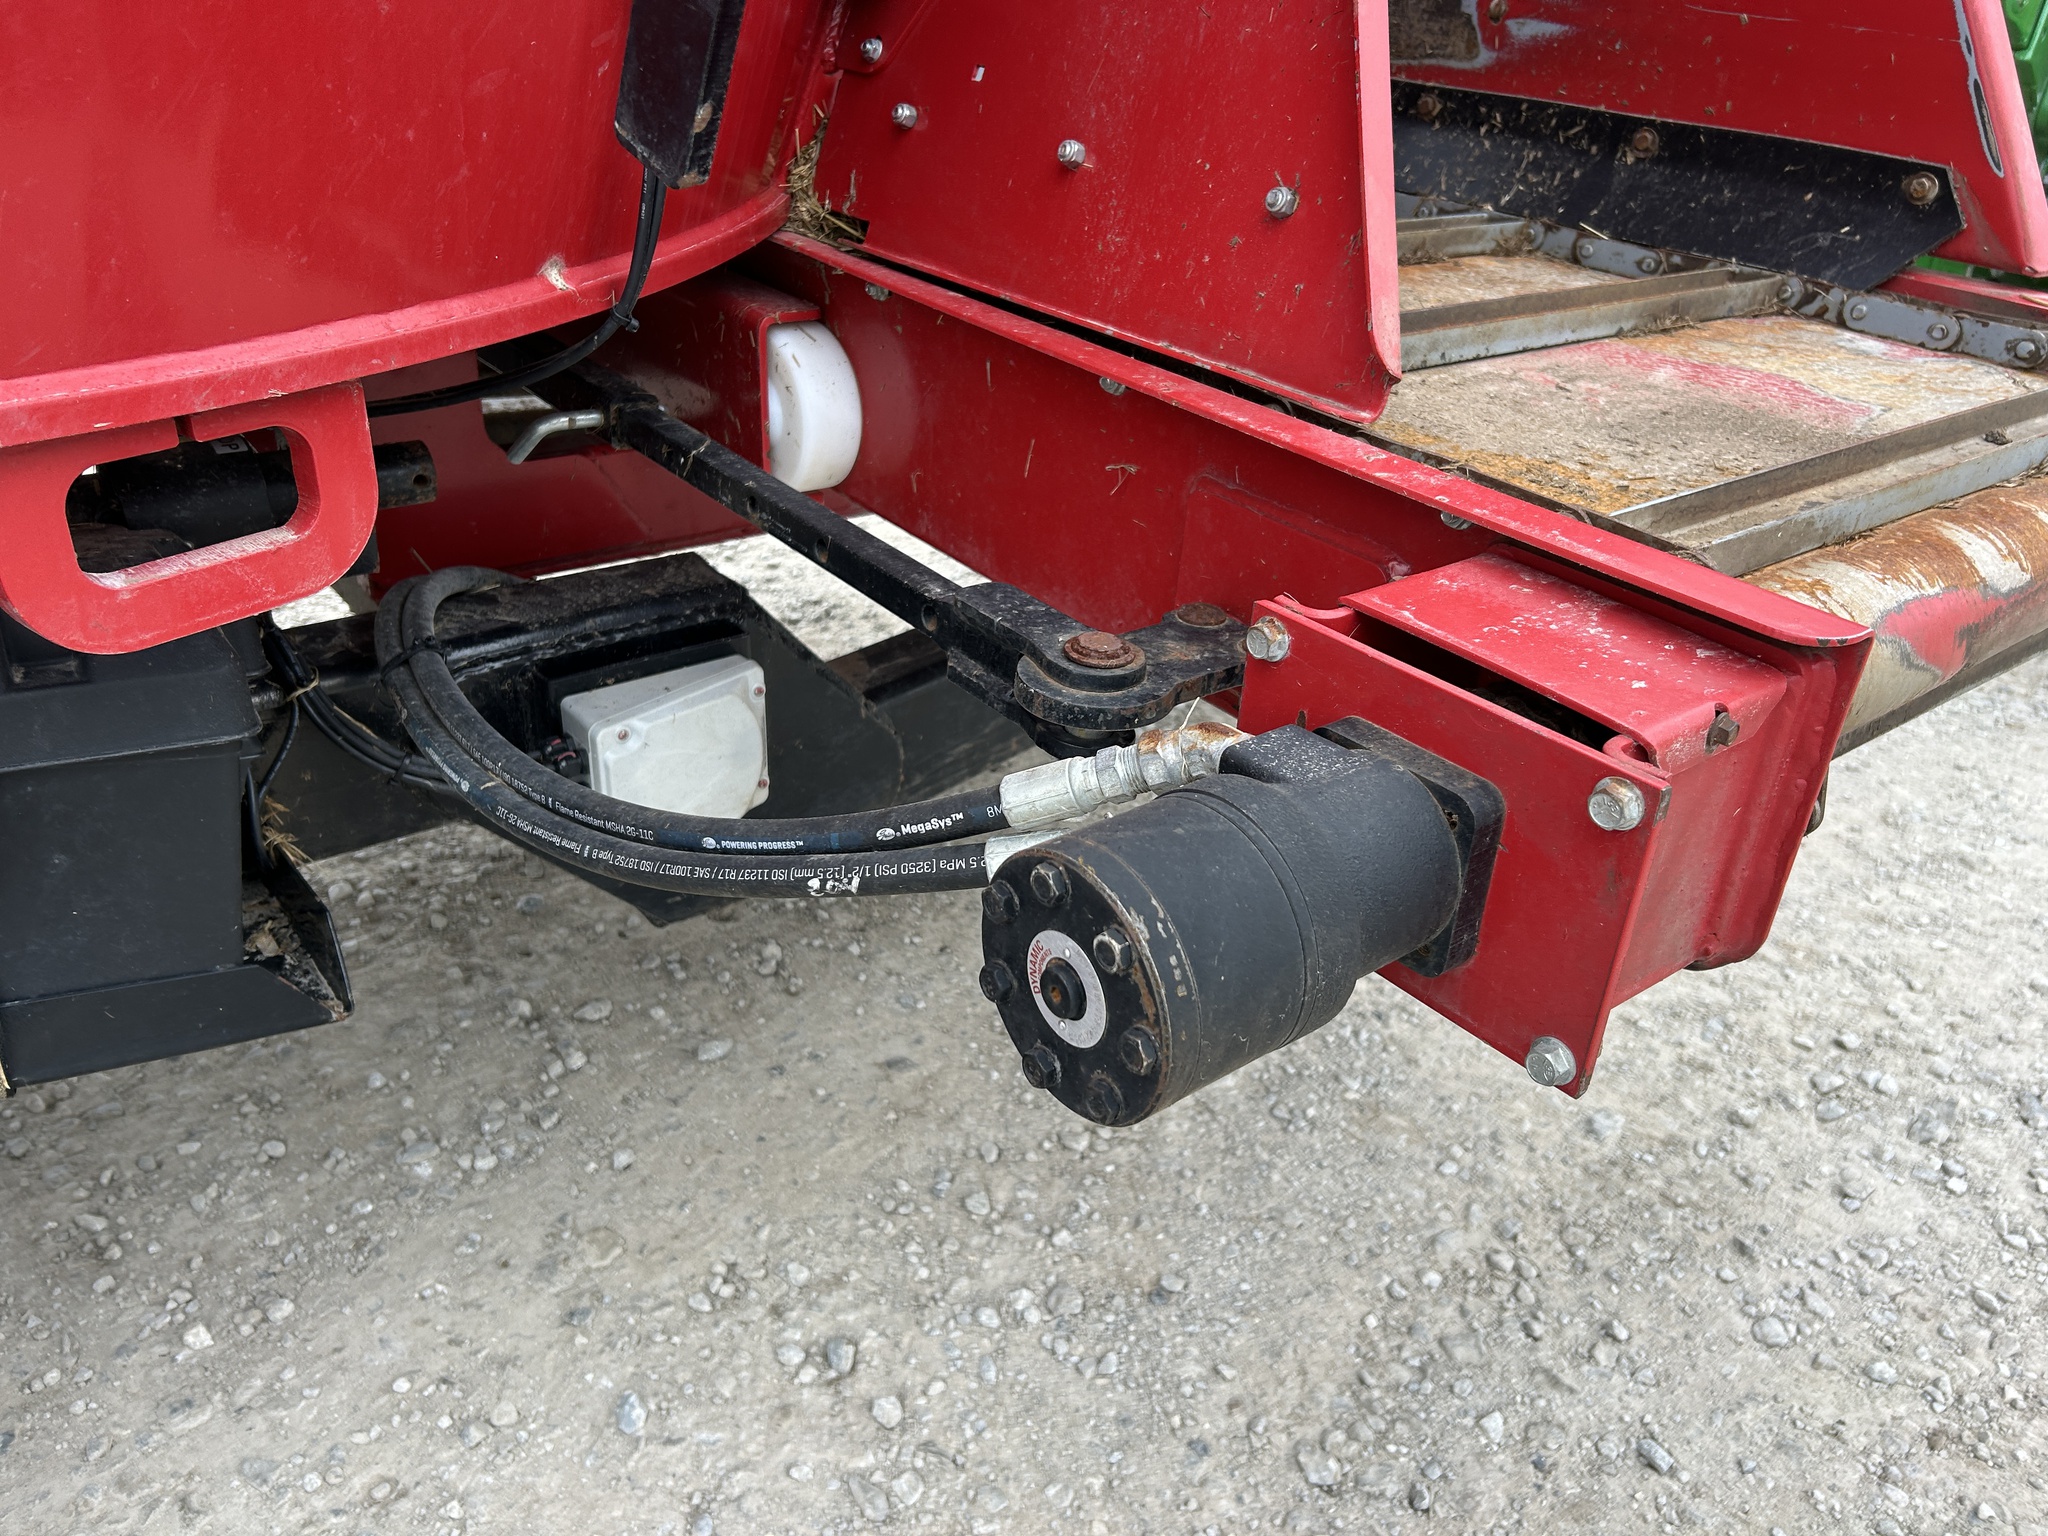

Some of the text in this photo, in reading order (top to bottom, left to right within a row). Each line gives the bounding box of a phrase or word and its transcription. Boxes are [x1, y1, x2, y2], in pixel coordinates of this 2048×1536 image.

[511, 777, 528, 794] 18752
[555, 801, 574, 818] Flame
[574, 809, 605, 829] Resistant
[605, 820, 626, 835] MSHA
[626, 826, 654, 841] 2G-11C
[516, 820, 532, 833] MSHA
[532, 827, 562, 846] Resistant
[561, 838, 582, 854] Flame
[721, 841, 757, 850] POWERING
[592, 848, 598, 859] B
[598, 850, 615, 864] Type
[615, 855, 639, 870] 18752
[640, 860, 654, 872] ISO
[940, 858, 966, 871] MPa
[660, 863, 692, 877] 100R17
[694, 866, 710, 879] SAE
[718, 868, 736, 880] R17
[738, 868, 770, 880] 11237
[772, 869, 788, 880] ISO
[1029, 940, 1044, 994] DYNAMIC
